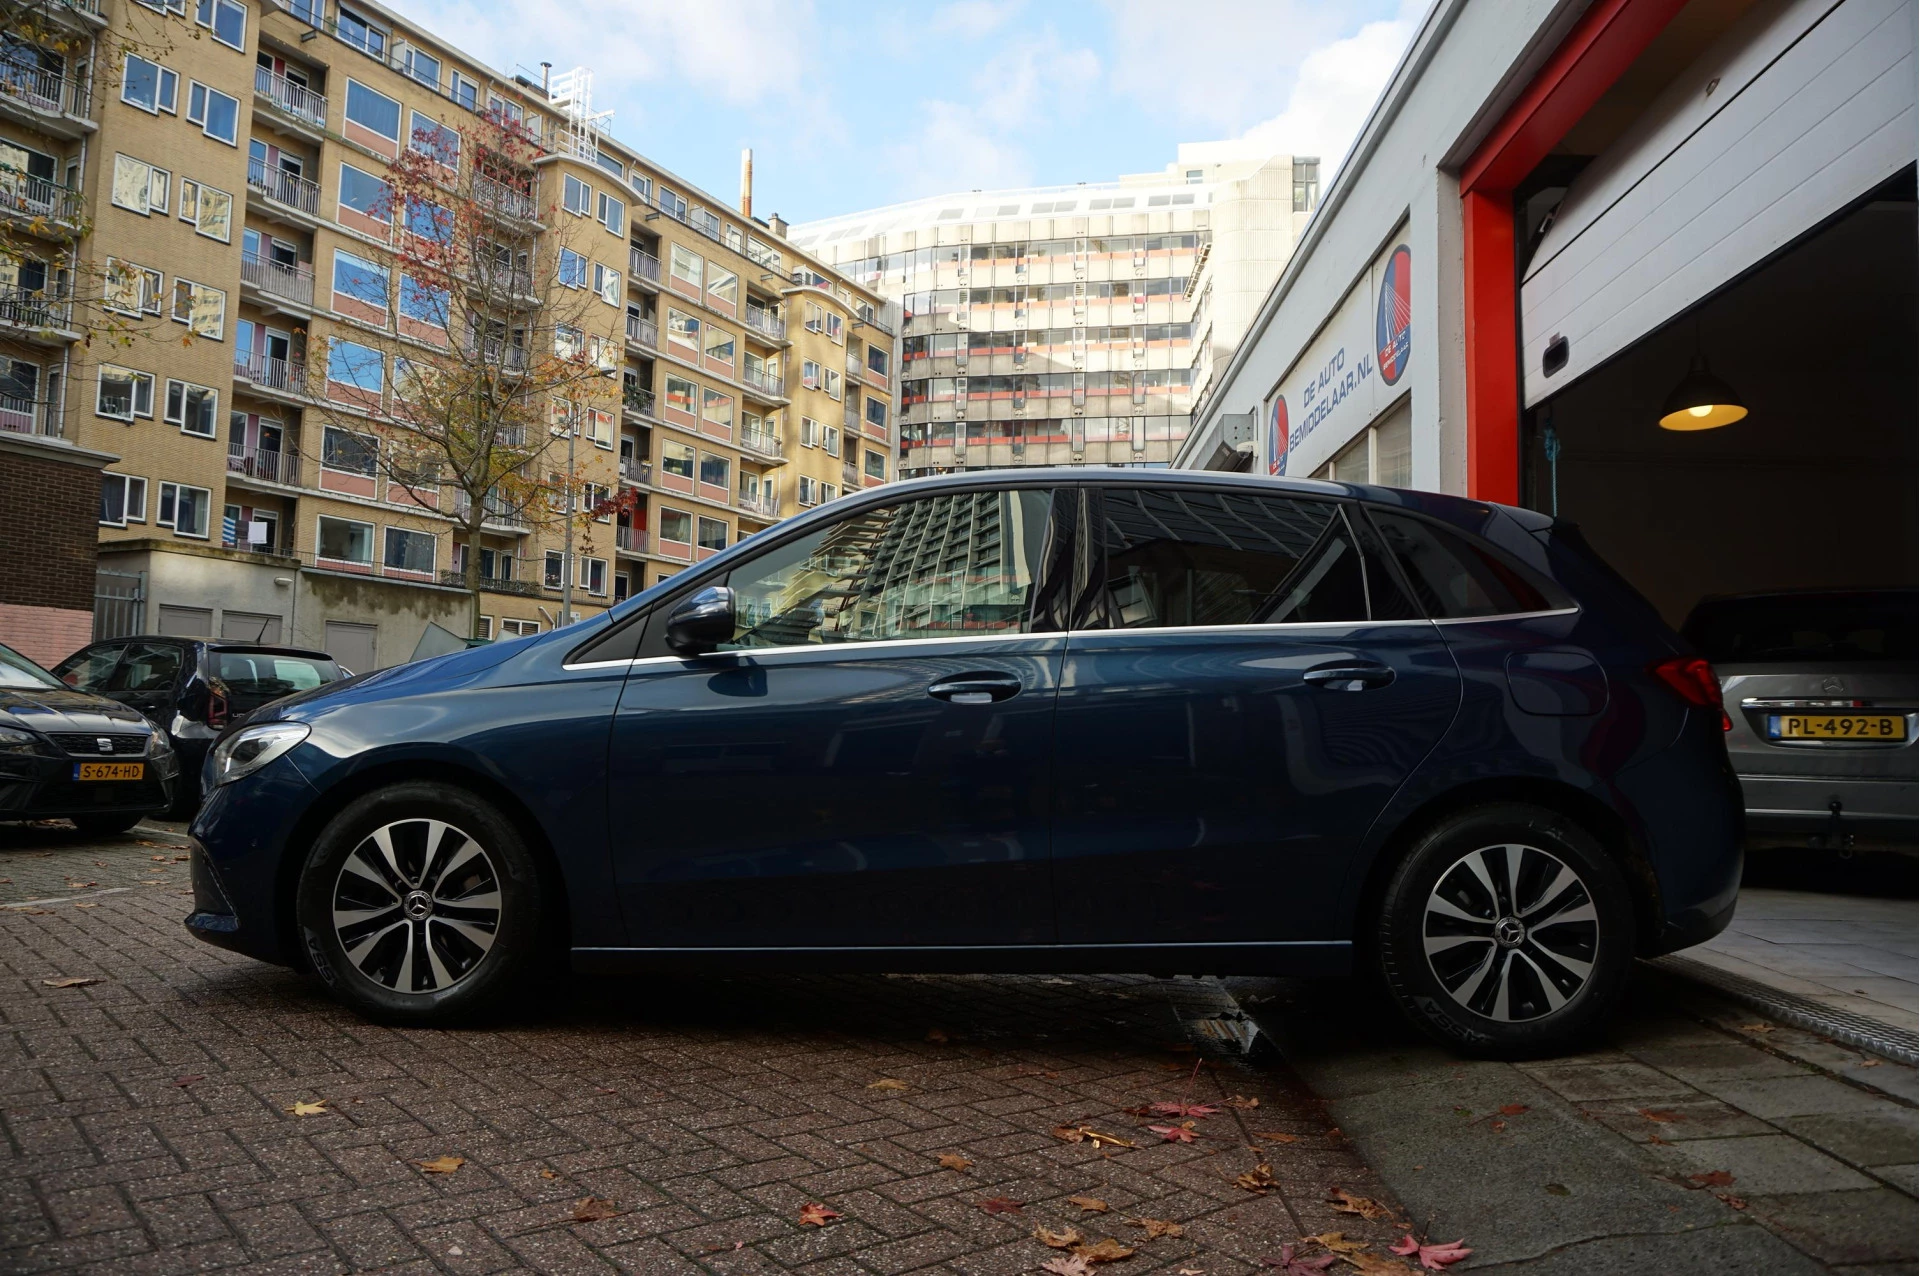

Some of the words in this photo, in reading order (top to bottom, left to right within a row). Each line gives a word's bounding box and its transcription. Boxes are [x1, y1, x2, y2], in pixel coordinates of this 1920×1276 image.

[1385, 345, 1391, 358] DE
[1304, 380, 1315, 408] DE
[1318, 347, 1344, 393] AUTO
[1289, 354, 1373, 453] BEMIDDELAAR.NL
[1788, 718, 1893, 736] PL-492-B
[83, 765, 140, 778] S-674-HD
